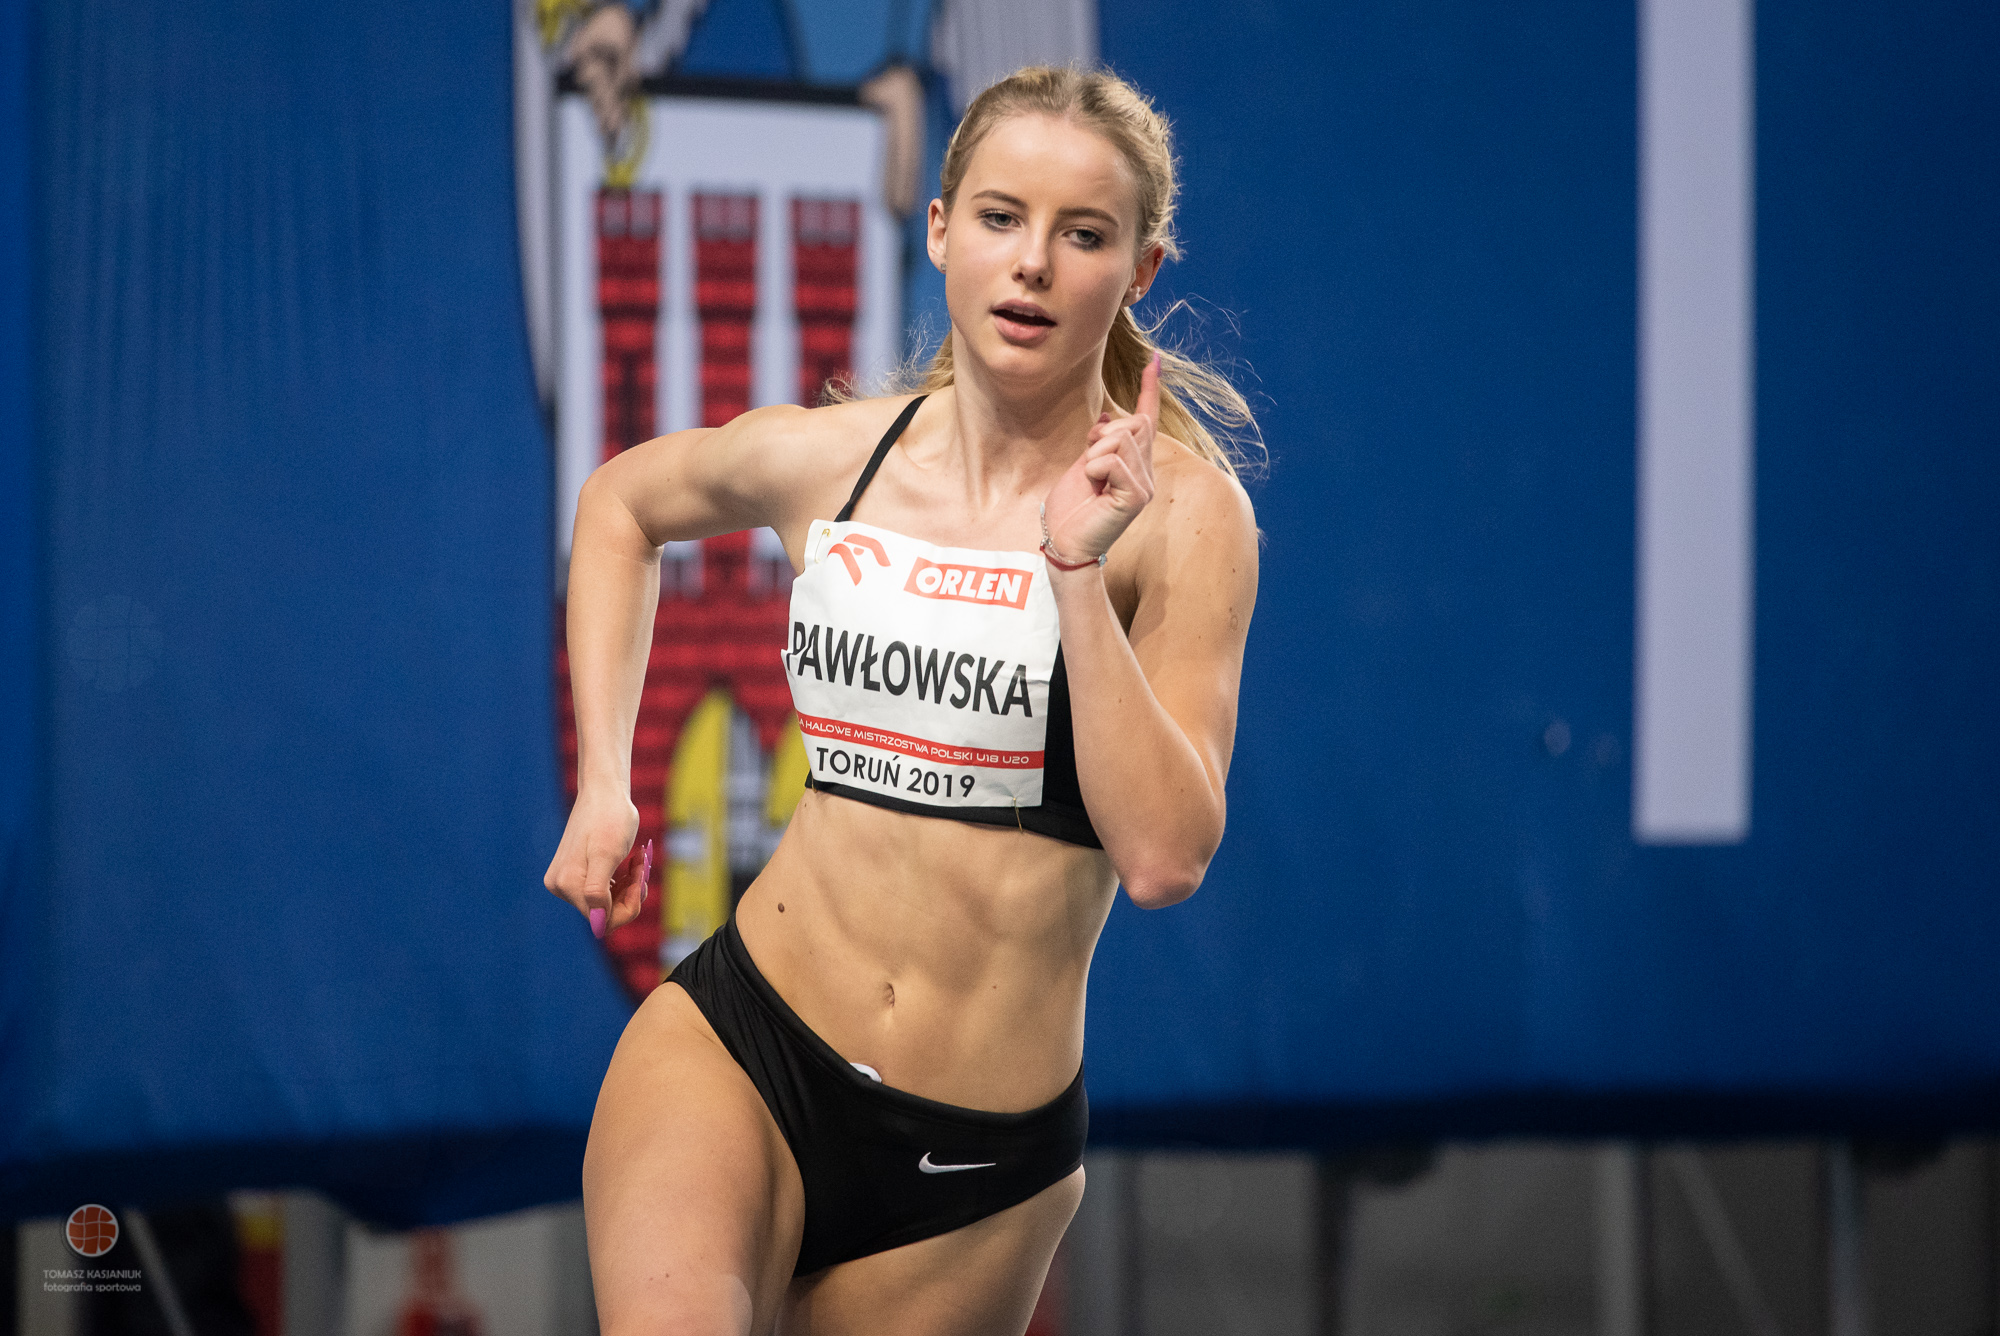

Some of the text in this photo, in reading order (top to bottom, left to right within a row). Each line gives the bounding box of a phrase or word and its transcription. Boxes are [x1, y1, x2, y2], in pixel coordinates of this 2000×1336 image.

[915, 567, 1023, 603] ORLEN
[786, 621, 1033, 718] PAWŁOWSKA
[805, 720, 851, 737] HALOWE
[853, 729, 929, 754] MISTRZOSTWA
[931, 747, 973, 761] POLSKI
[976, 754, 999, 763] U18
[1002, 755, 1030, 764] U20
[816, 747, 976, 798] TORUŃ 2019
